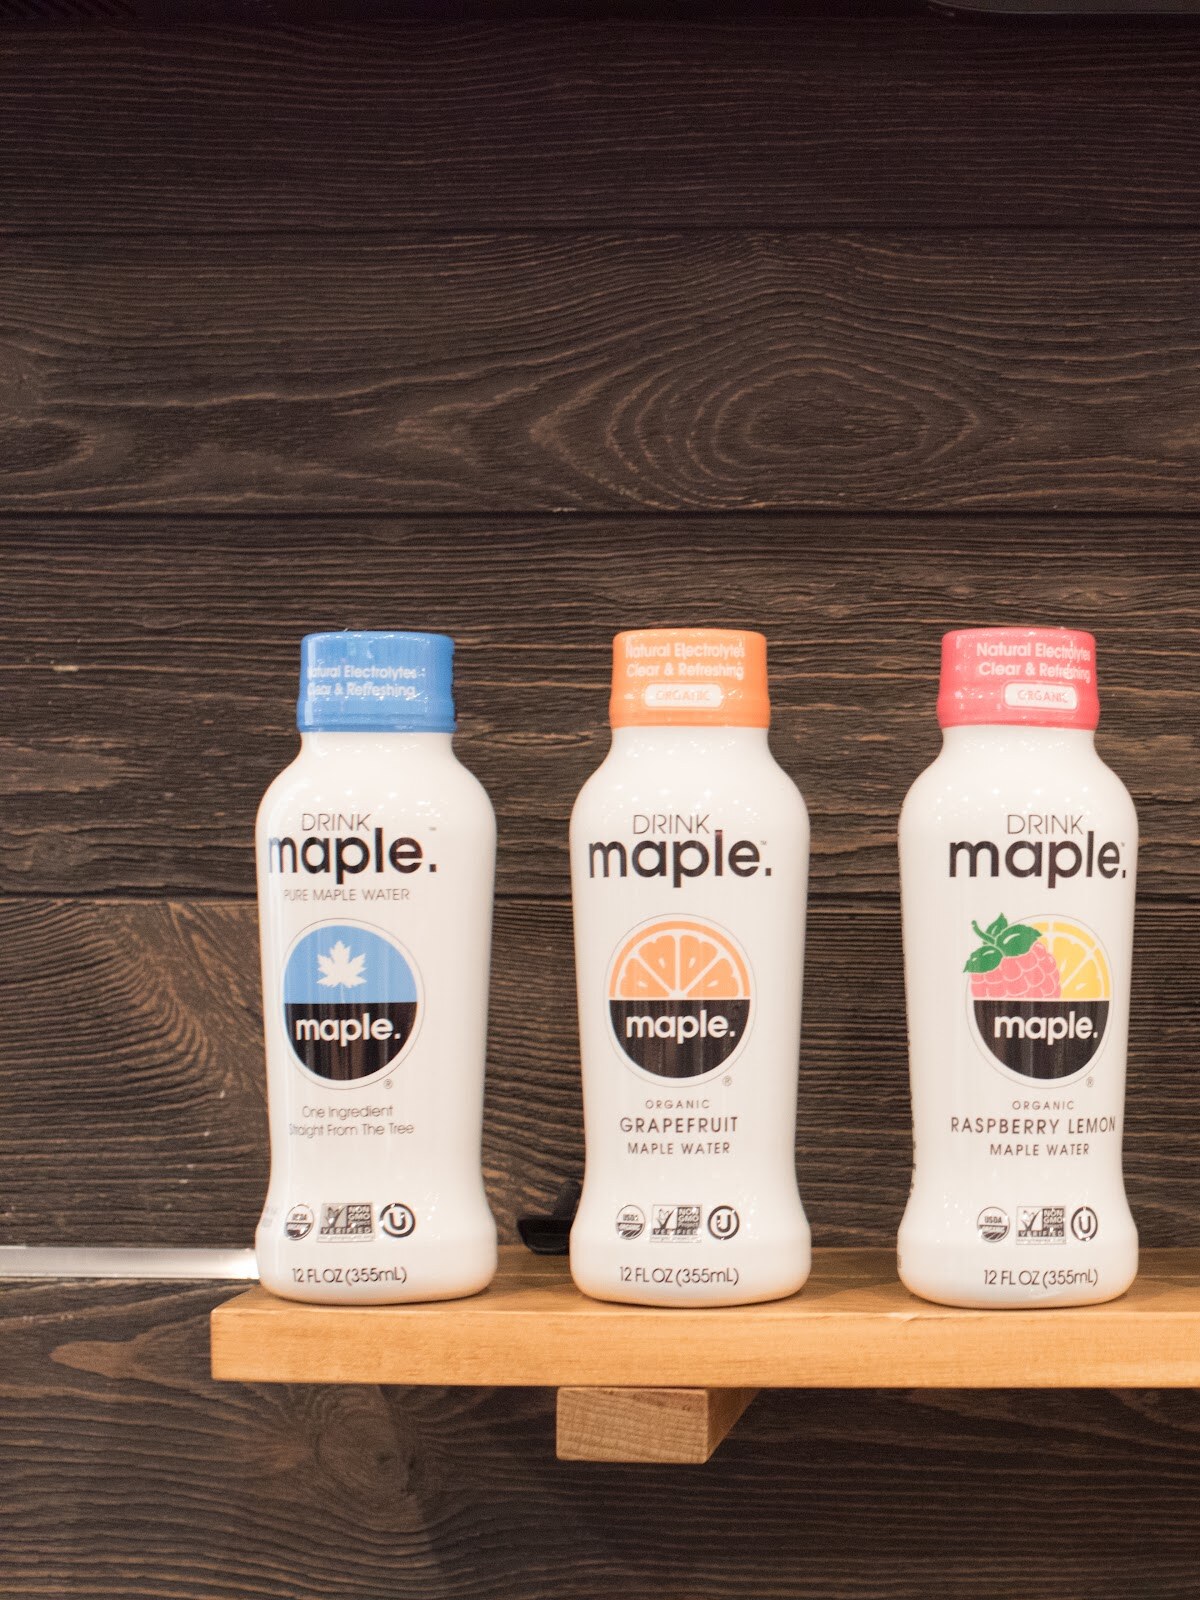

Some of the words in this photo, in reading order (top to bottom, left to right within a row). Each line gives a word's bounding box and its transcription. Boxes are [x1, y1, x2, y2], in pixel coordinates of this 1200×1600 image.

[625, 643, 670, 658] Natural
[976, 642, 1031, 657] Natural
[344, 665, 417, 681] Electrolytes
[626, 662, 660, 677] Clear
[664, 662, 674, 676] &
[978, 662, 1021, 676] Clear
[1025, 662, 1036, 676] &
[347, 682, 416, 699] Refreshing
[301, 813, 372, 832] DRINK
[632, 814, 711, 834] DRINK
[1007, 814, 1084, 835] DRINK
[268, 827, 437, 885] maple.
[589, 829, 772, 888] maple.
[949, 830, 1126, 889] maple.
[312, 888, 357, 901] MAPLE
[361, 888, 410, 901] WATER
[295, 1013, 401, 1047] maple.
[626, 1010, 736, 1044] maple.
[994, 1011, 1098, 1045] maple.
[302, 1105, 325, 1118] One
[328, 1104, 393, 1121] Ingredient
[645, 1099, 710, 1109] ORGANIC
[1012, 1100, 1074, 1111] ORGANIC
[328, 1124, 358, 1136] From
[362, 1123, 386, 1135] The
[389, 1123, 414, 1135] Tree
[619, 1116, 738, 1133] GRAPEFRUIT
[951, 1117, 1060, 1134] RASPBERRY
[1068, 1116, 1116, 1133] LEMON
[627, 1142, 674, 1155] MAPLE
[681, 1142, 731, 1155] WATER
[990, 1143, 1040, 1156] MAPLE
[1046, 1143, 1090, 1156] WATER
[292, 1267, 305, 1282] 12
[307, 1268, 327, 1283] FL
[327, 1268, 345, 1283] OZ
[345, 1266, 407, 1285] (355mL)
[620, 1266, 632, 1282] 12
[635, 1268, 649, 1283] FL
[652, 1268, 673, 1283] OZ
[676, 1266, 739, 1287] (355mL)
[984, 1270, 997, 1285] 12
[1001, 1270, 1016, 1285] FL
[1018, 1270, 1040, 1285] OZ
[1043, 1268, 1098, 1289] (355mL)
